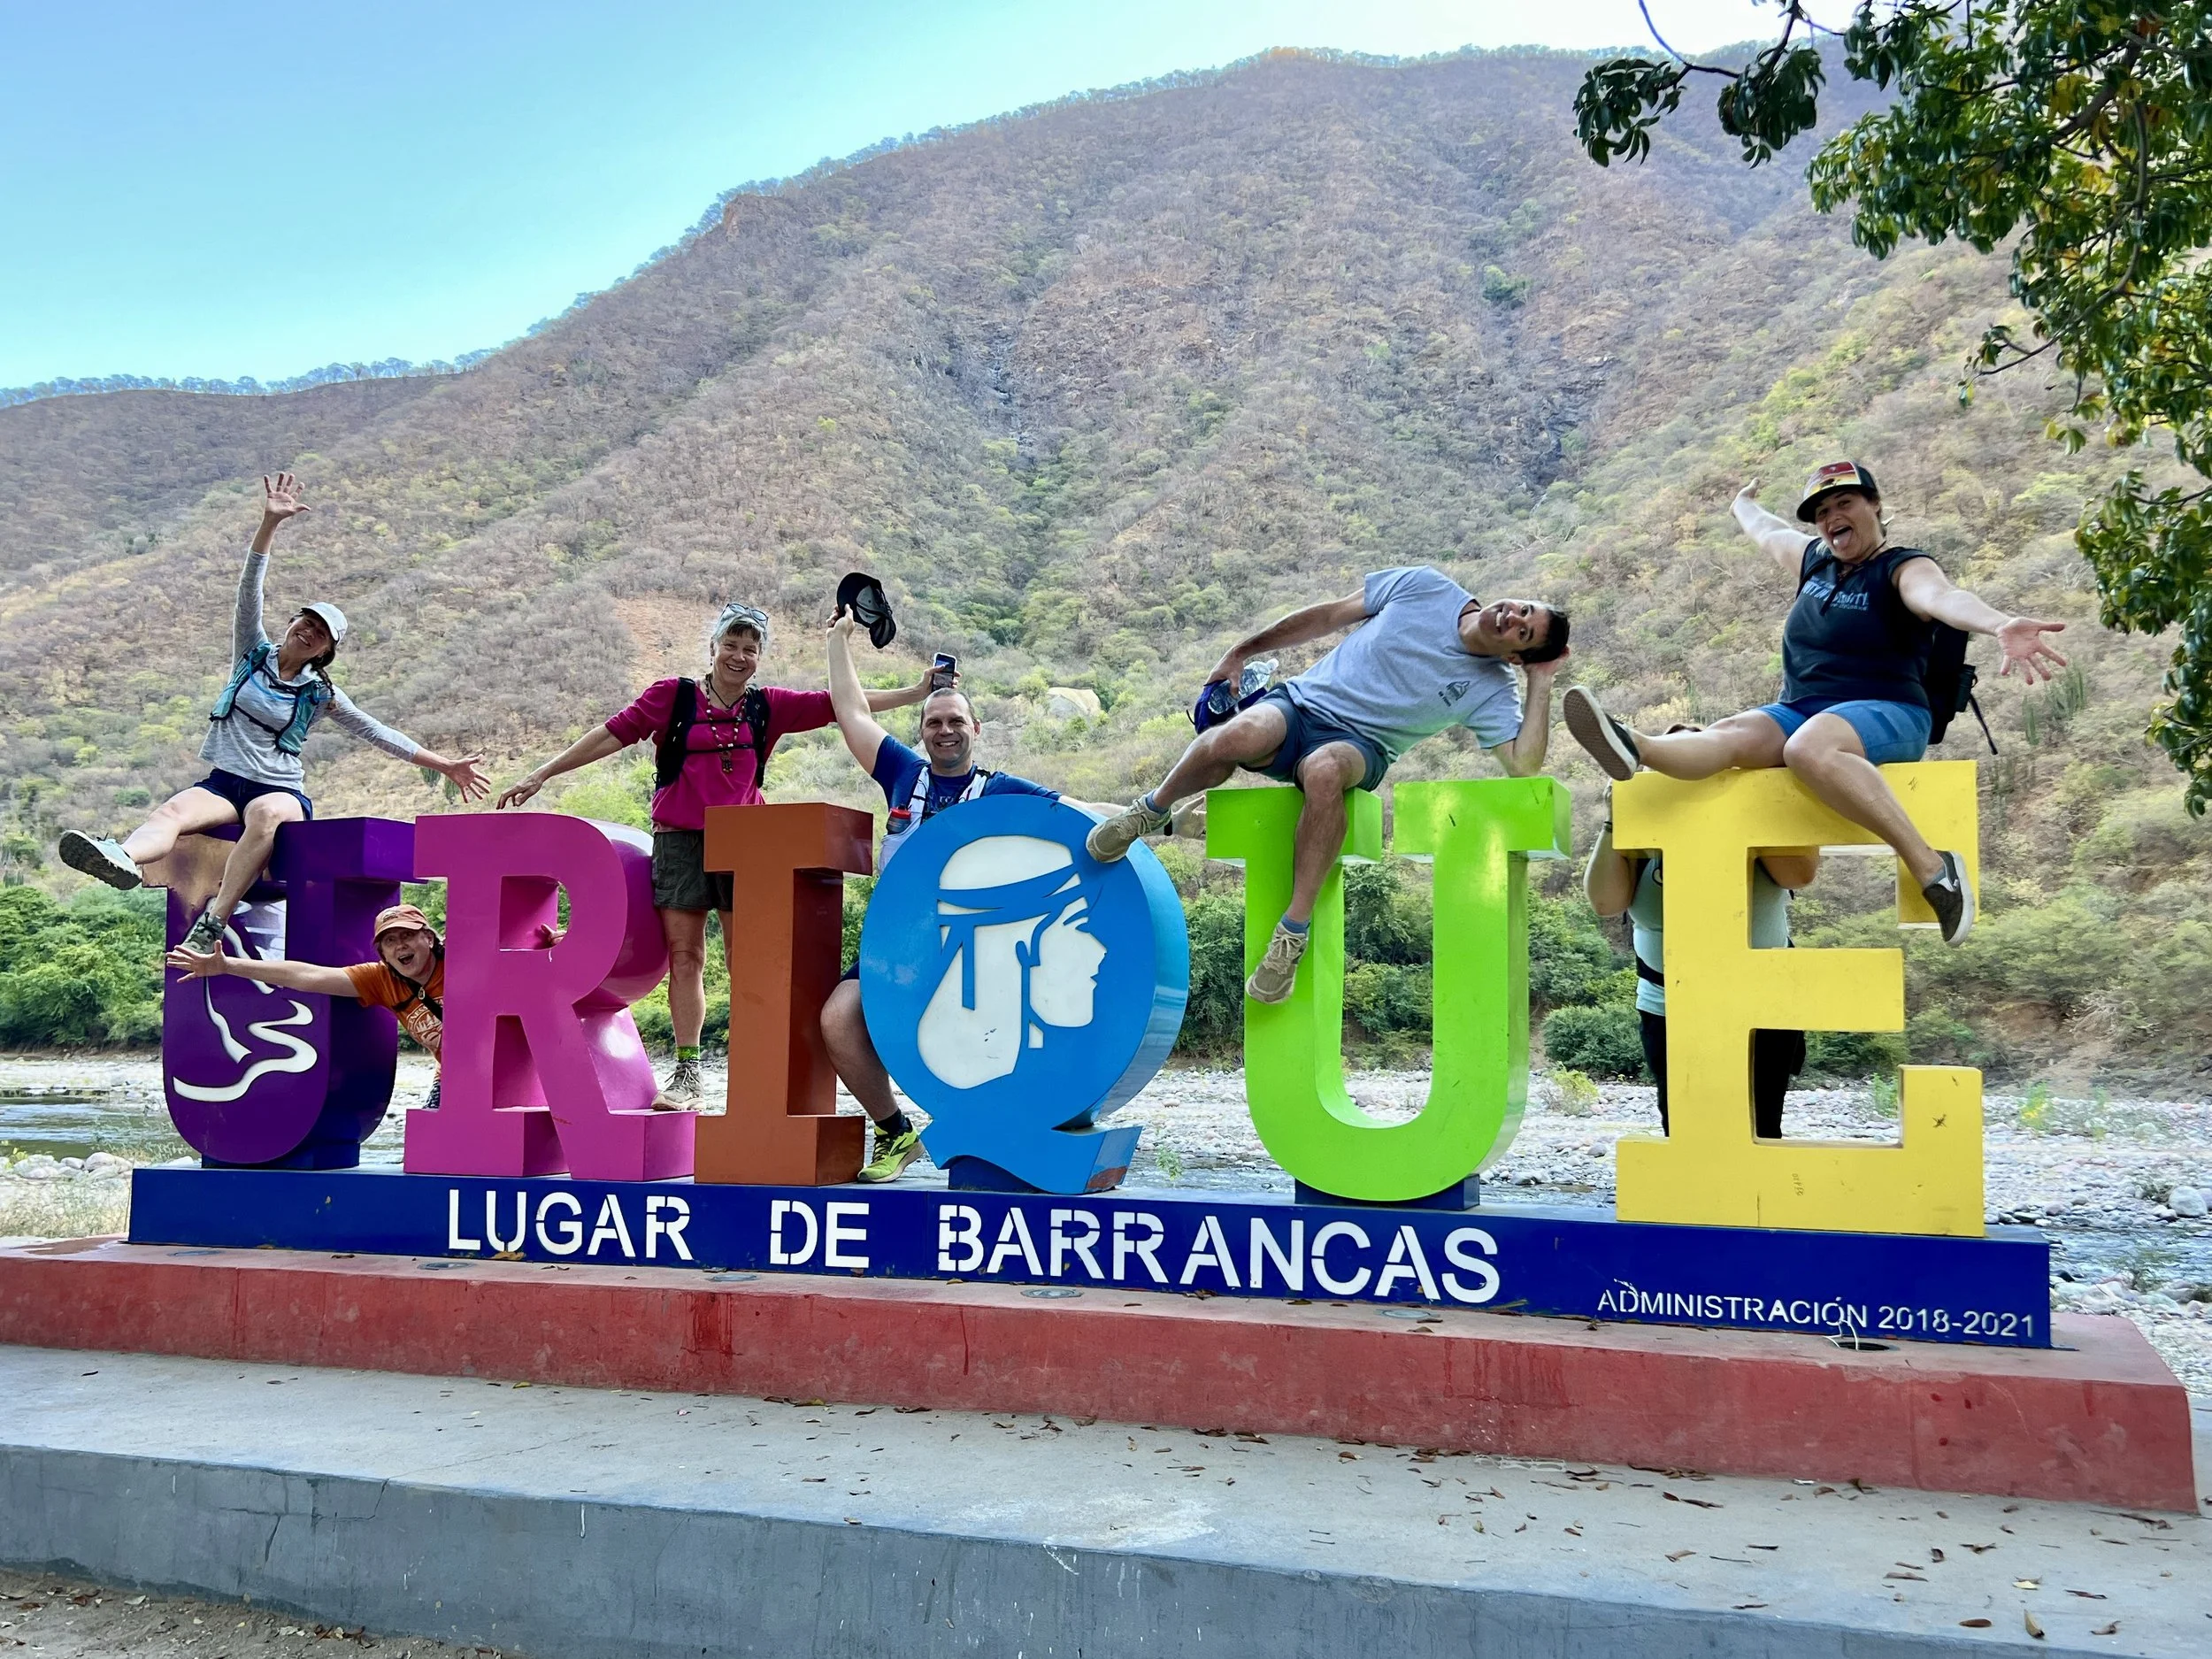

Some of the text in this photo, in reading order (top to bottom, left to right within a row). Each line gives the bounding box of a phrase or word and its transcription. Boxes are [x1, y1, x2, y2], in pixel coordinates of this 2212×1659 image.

[142, 759, 1984, 1237] URIQUE
[449, 1189, 1500, 1303] LUGAR DE BARRANCAS
[1598, 1289, 2032, 1338] ADMINISTRACIÓN 2018-2021
